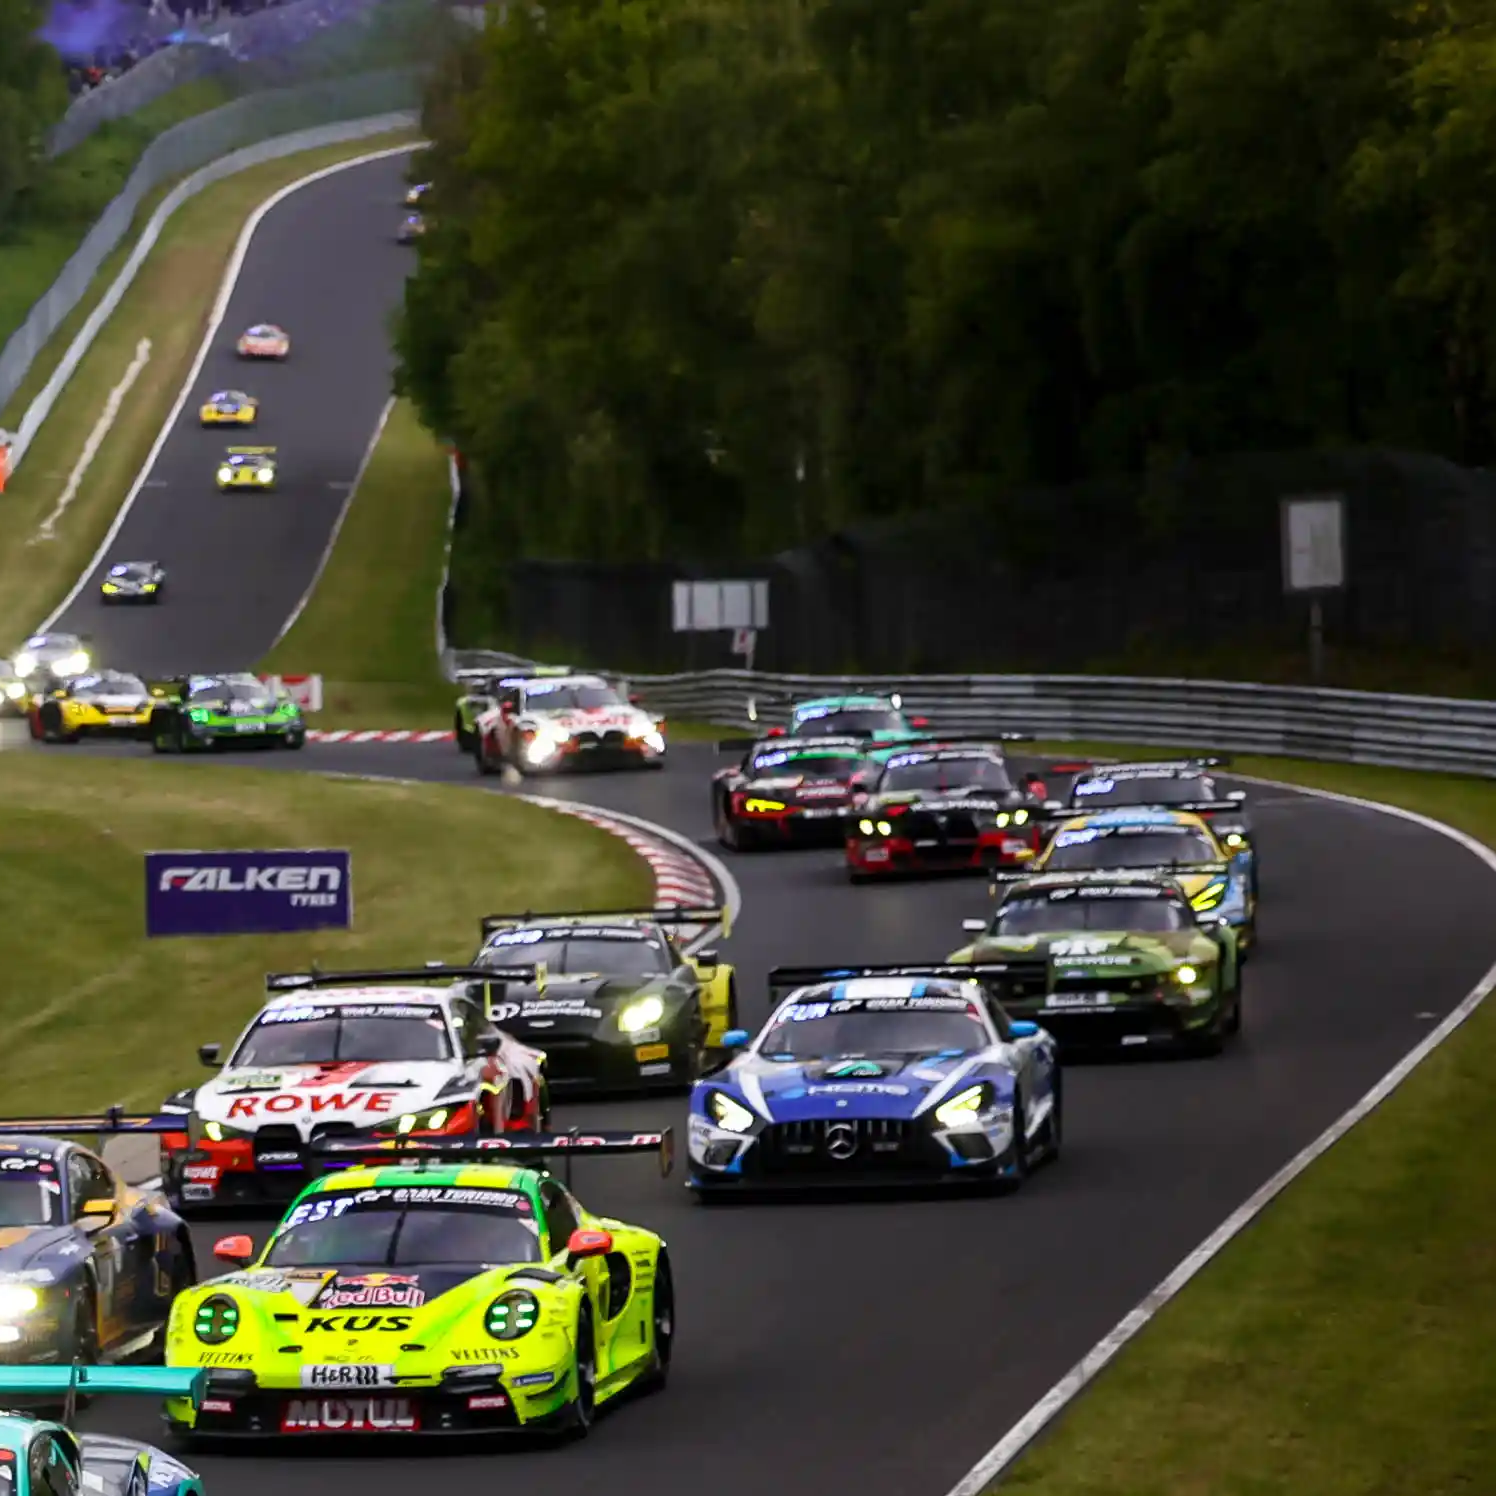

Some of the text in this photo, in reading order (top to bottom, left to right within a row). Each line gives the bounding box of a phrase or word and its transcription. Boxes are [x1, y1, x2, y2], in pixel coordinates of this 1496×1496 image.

[160, 867, 342, 892] FALKEN
[290, 893, 337, 908] TYRES
[227, 1092, 400, 1119] ROWE
[393, 1188, 442, 1201] GRAN
[373, 1285, 425, 1309] Bull
[305, 1314, 414, 1333] KÜS
[451, 1347, 520, 1361] VELTINS
[311, 1366, 354, 1385] H&R
[284, 1398, 414, 1428] MOTUL
